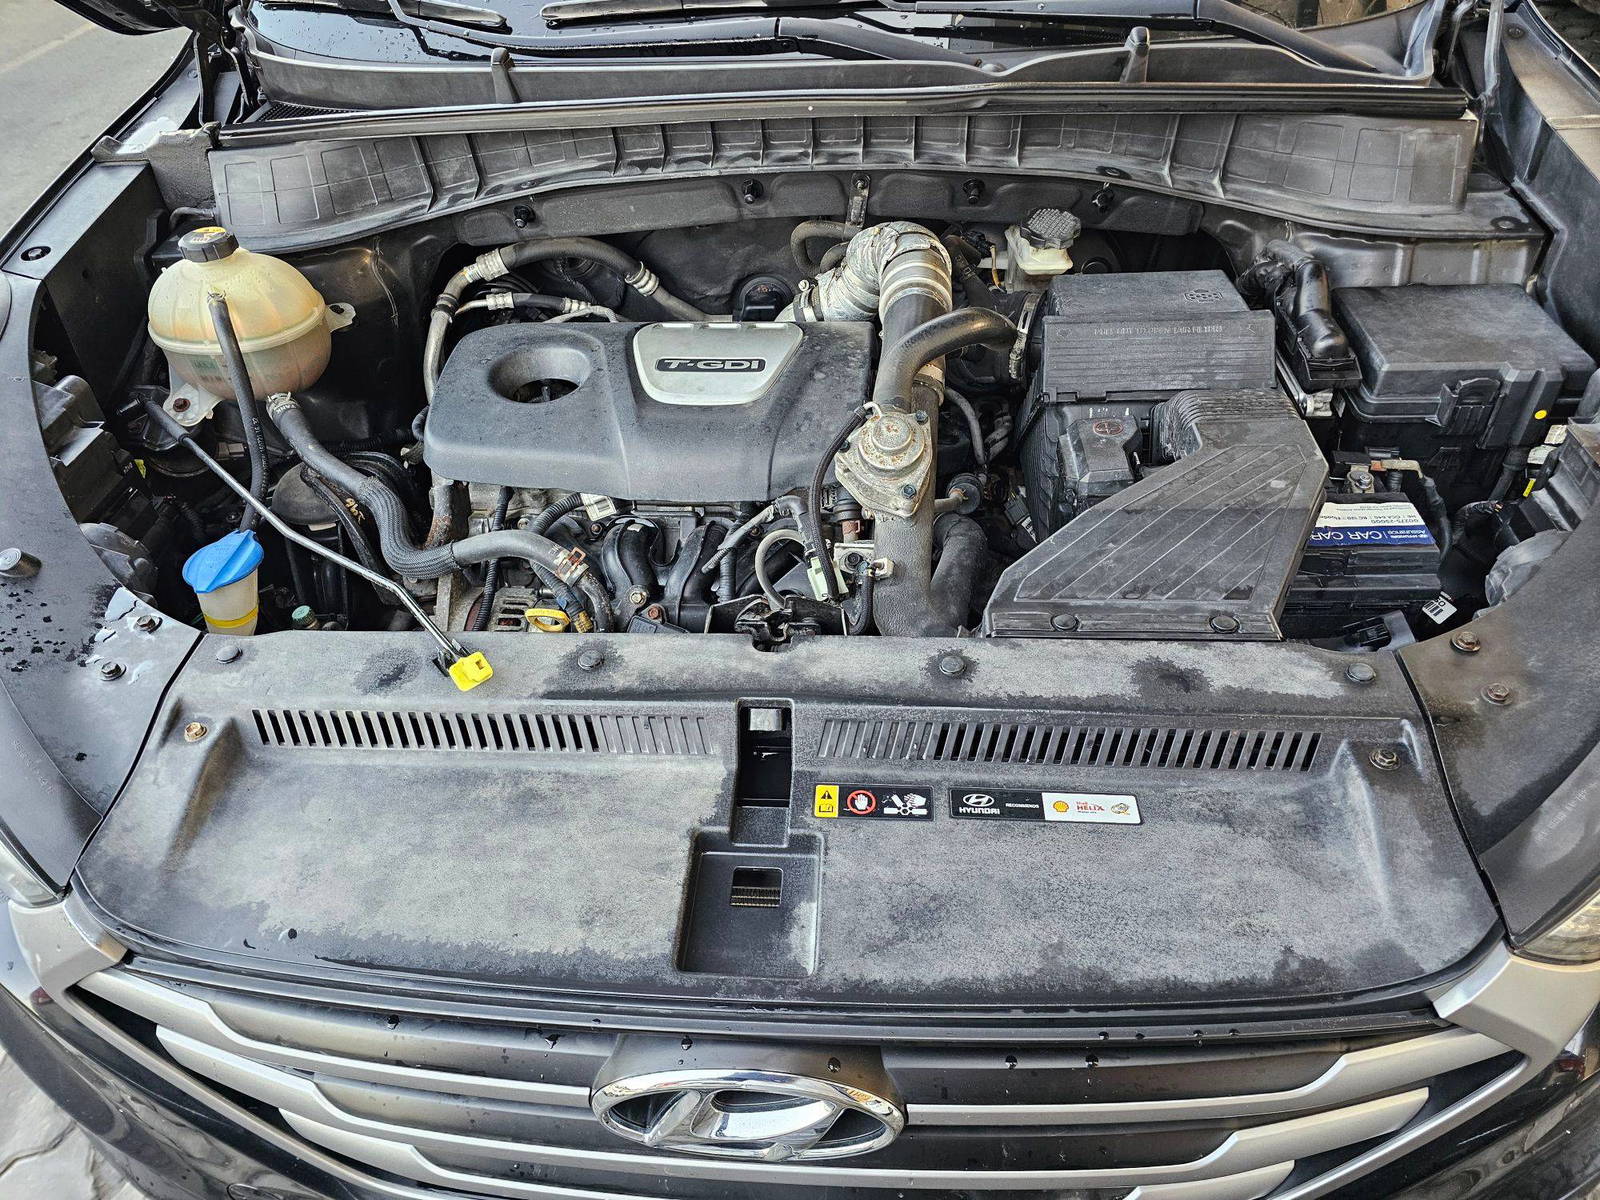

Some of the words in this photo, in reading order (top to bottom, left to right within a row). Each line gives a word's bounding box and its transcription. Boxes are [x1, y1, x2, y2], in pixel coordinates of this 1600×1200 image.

[664, 360, 759, 370] T-GDI
[1310, 531, 1344, 541] CAR
[1347, 530, 1382, 540] CAR
[959, 806, 1000, 815] HYUNDAI
[1076, 804, 1105, 812] HELIX
